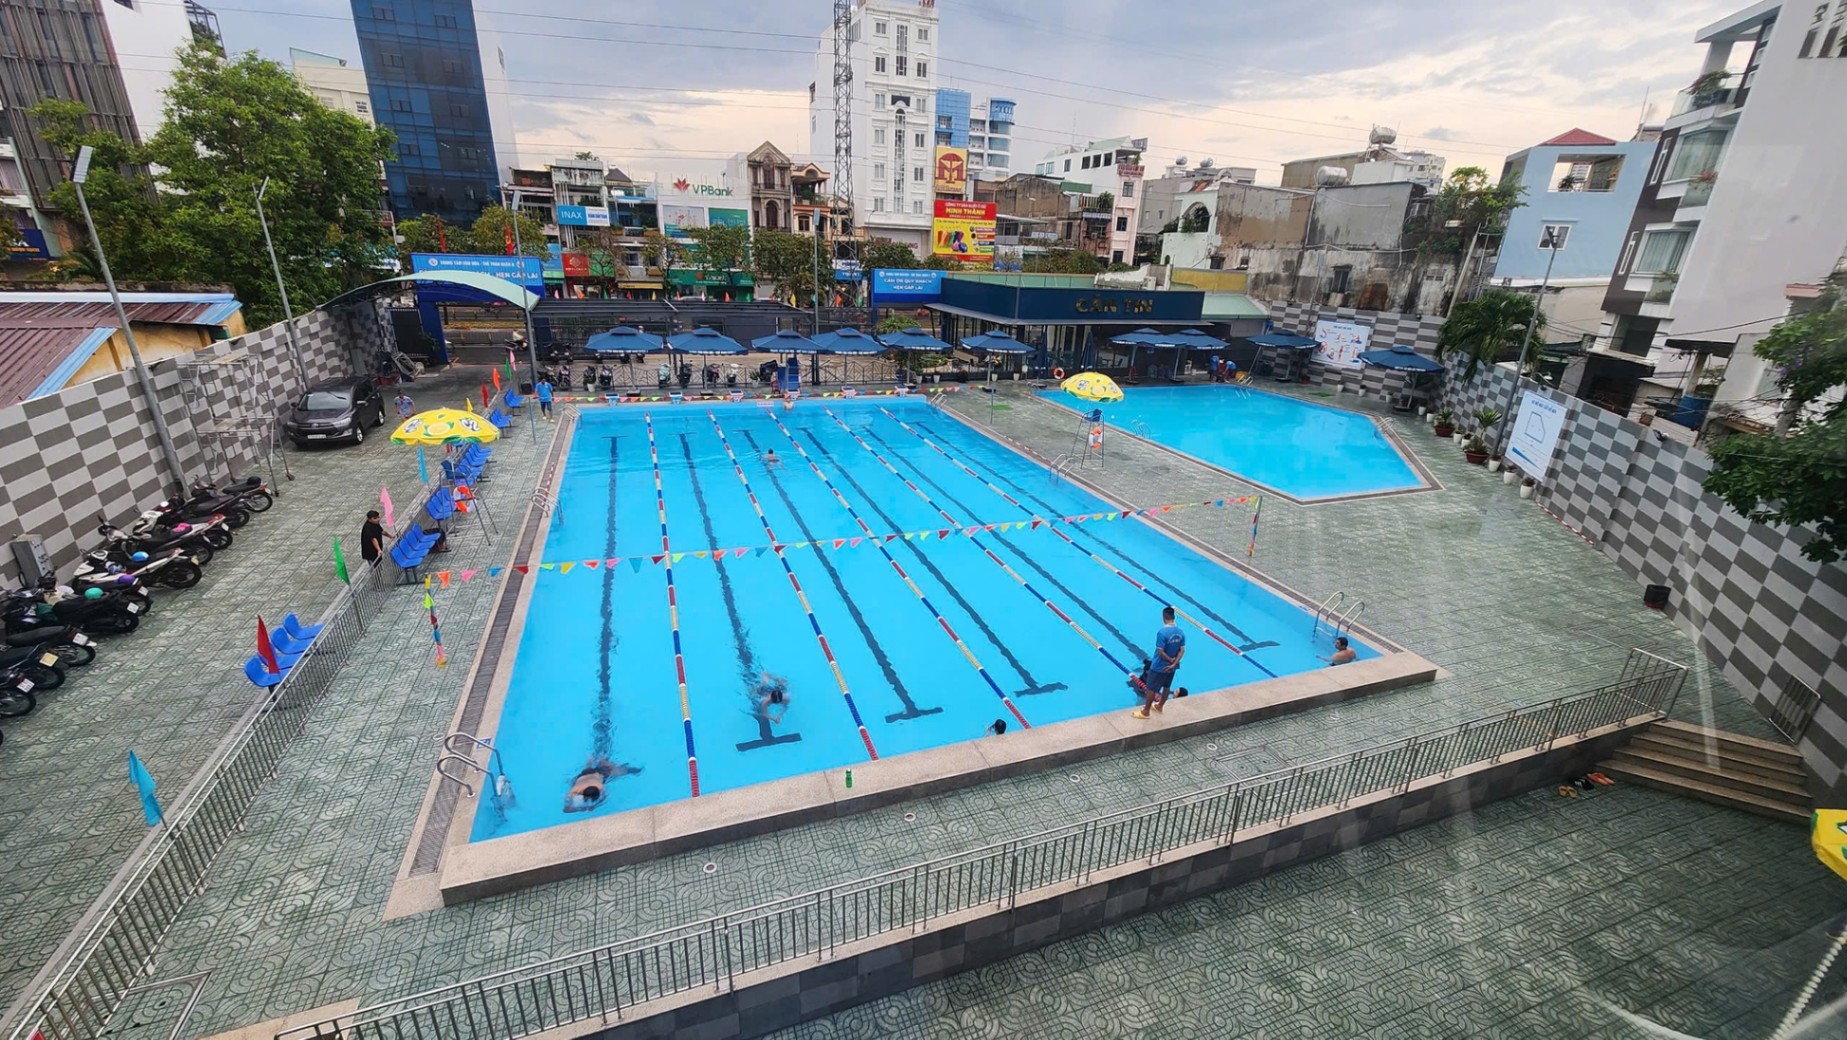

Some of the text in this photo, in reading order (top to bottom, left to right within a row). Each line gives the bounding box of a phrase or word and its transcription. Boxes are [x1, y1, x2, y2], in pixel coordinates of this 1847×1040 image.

[692, 184, 735, 198] VPBank
[561, 210, 583, 220] INAX
[1125, 299, 1153, 313] TIN
